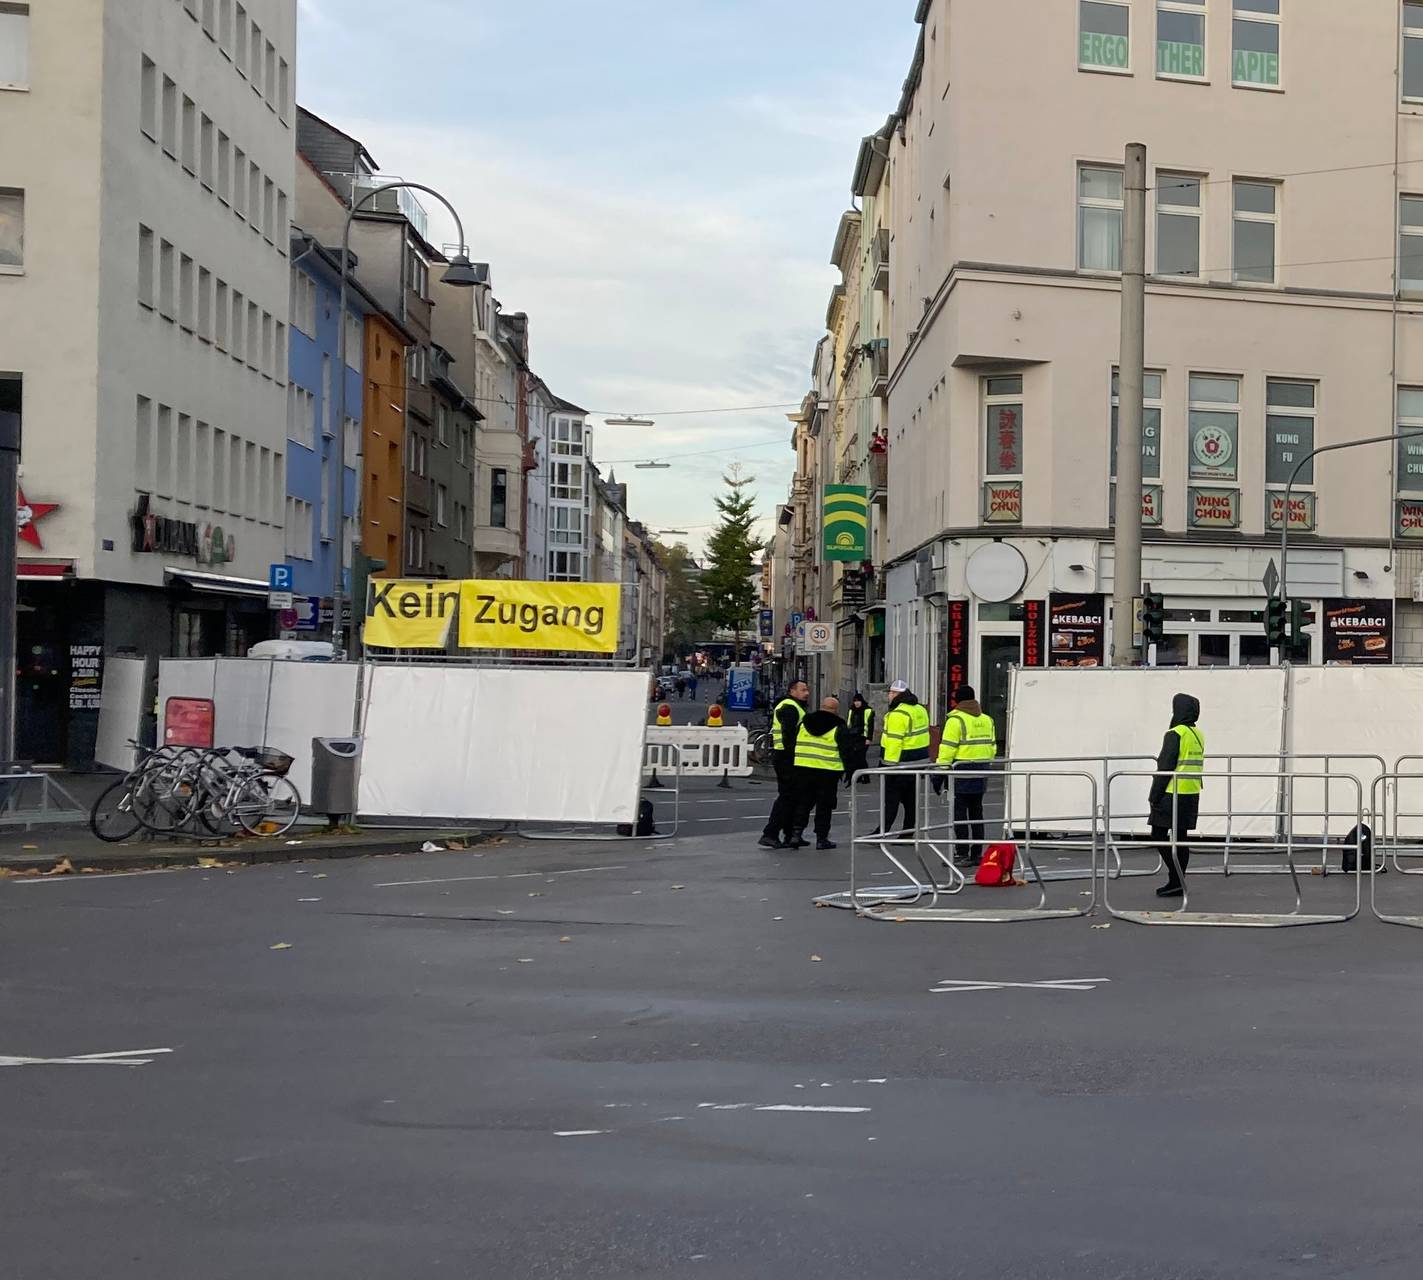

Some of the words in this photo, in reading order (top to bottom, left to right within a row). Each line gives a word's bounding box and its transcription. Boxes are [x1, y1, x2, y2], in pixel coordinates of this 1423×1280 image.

[1080, 32, 1127, 67] ERGO
[1158, 41, 1203, 74] THER
[1234, 51, 1278, 83] APIE
[1276, 433, 1299, 444] KUNG
[1282, 452, 1293, 463] FU
[991, 490, 1019, 499] WING
[990, 502, 1019, 512] CHUN
[1196, 496, 1230, 507] WING
[1273, 499, 1305, 510] WNG
[1195, 508, 1231, 519] CHUN
[275, 568, 288, 586] P
[366, 583, 460, 618] Kein
[474, 595, 604, 635] Zugang
[1059, 615, 1101, 624] KEBABCI
[1338, 617, 1386, 627] KEBABCI
[814, 630, 826, 639] 30
[951, 603, 962, 655] CRISPY
[70, 645, 101, 656] HAPPY
[72, 657, 99, 668] HOUR
